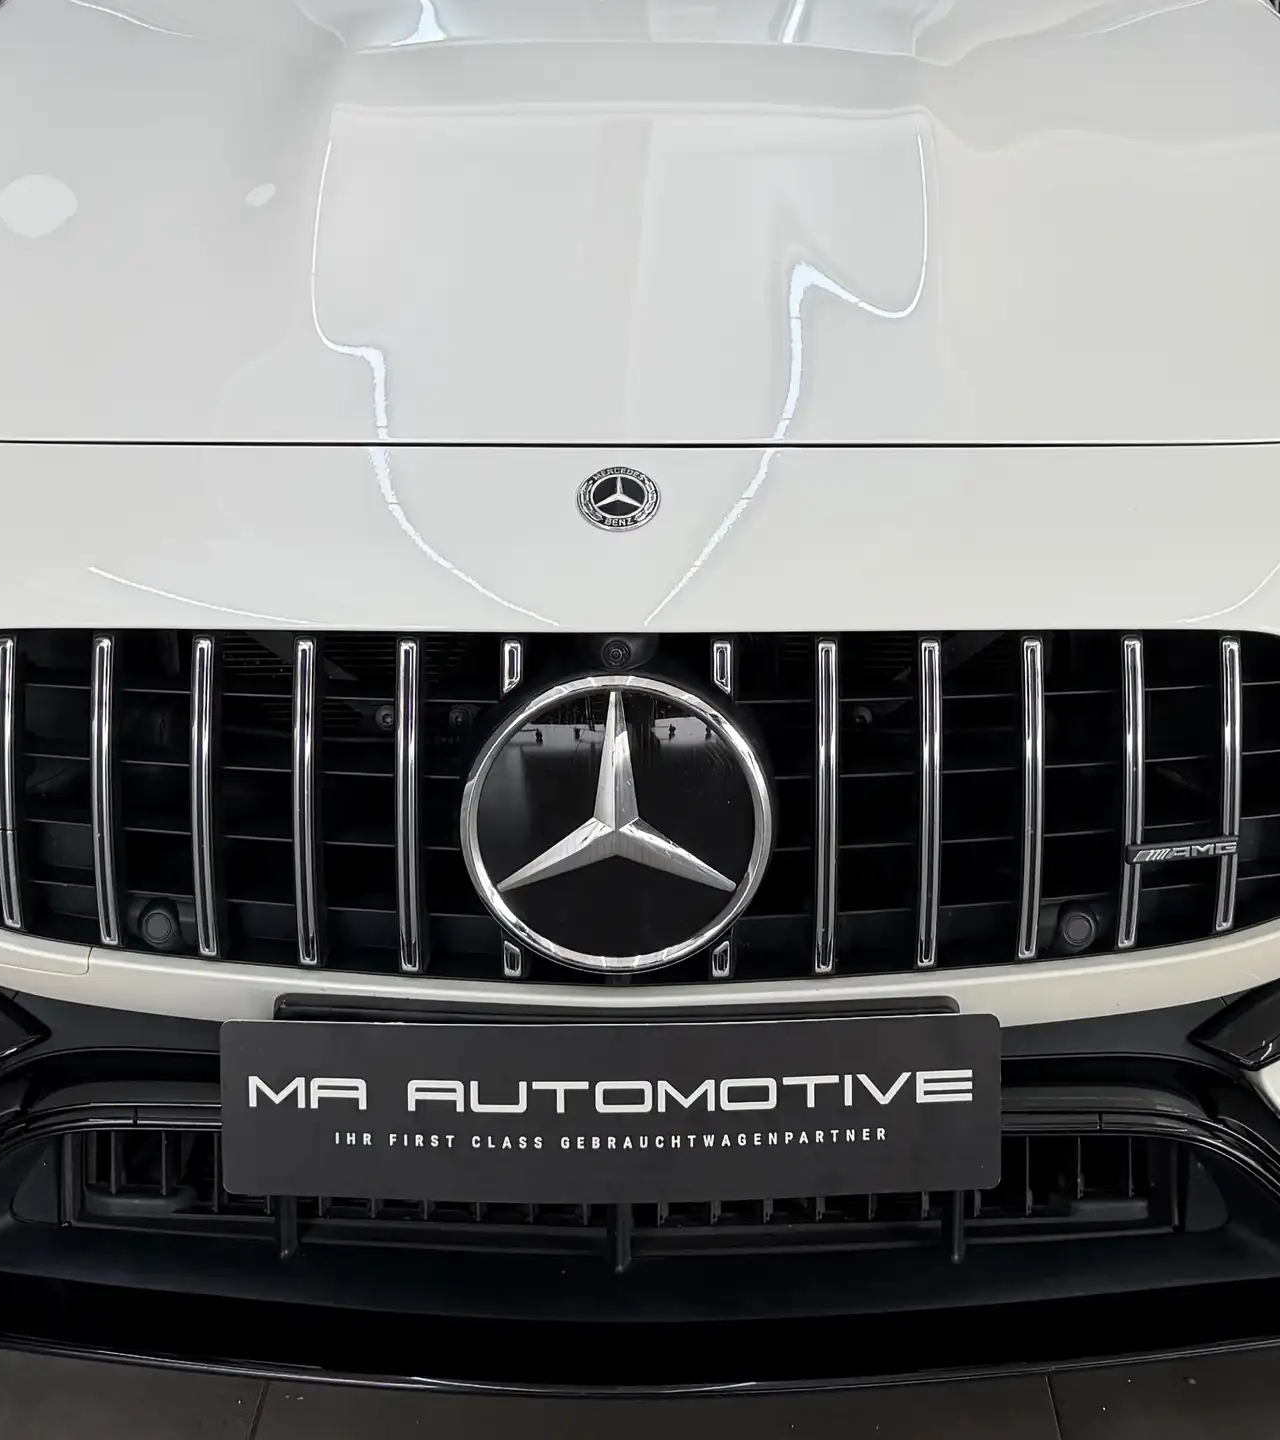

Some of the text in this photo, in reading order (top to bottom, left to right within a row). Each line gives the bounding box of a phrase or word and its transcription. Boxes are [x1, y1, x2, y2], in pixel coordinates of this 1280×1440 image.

[592, 467, 646, 481] MERCEDES
[604, 517, 634, 527] BENZ
[1170, 841, 1237, 858] AMG
[248, 1069, 973, 1114] MA AUTOMOTIVE
[335, 1127, 886, 1150] IHR FIRST CLASS GEBRAUCHTWAGENPARTNER
